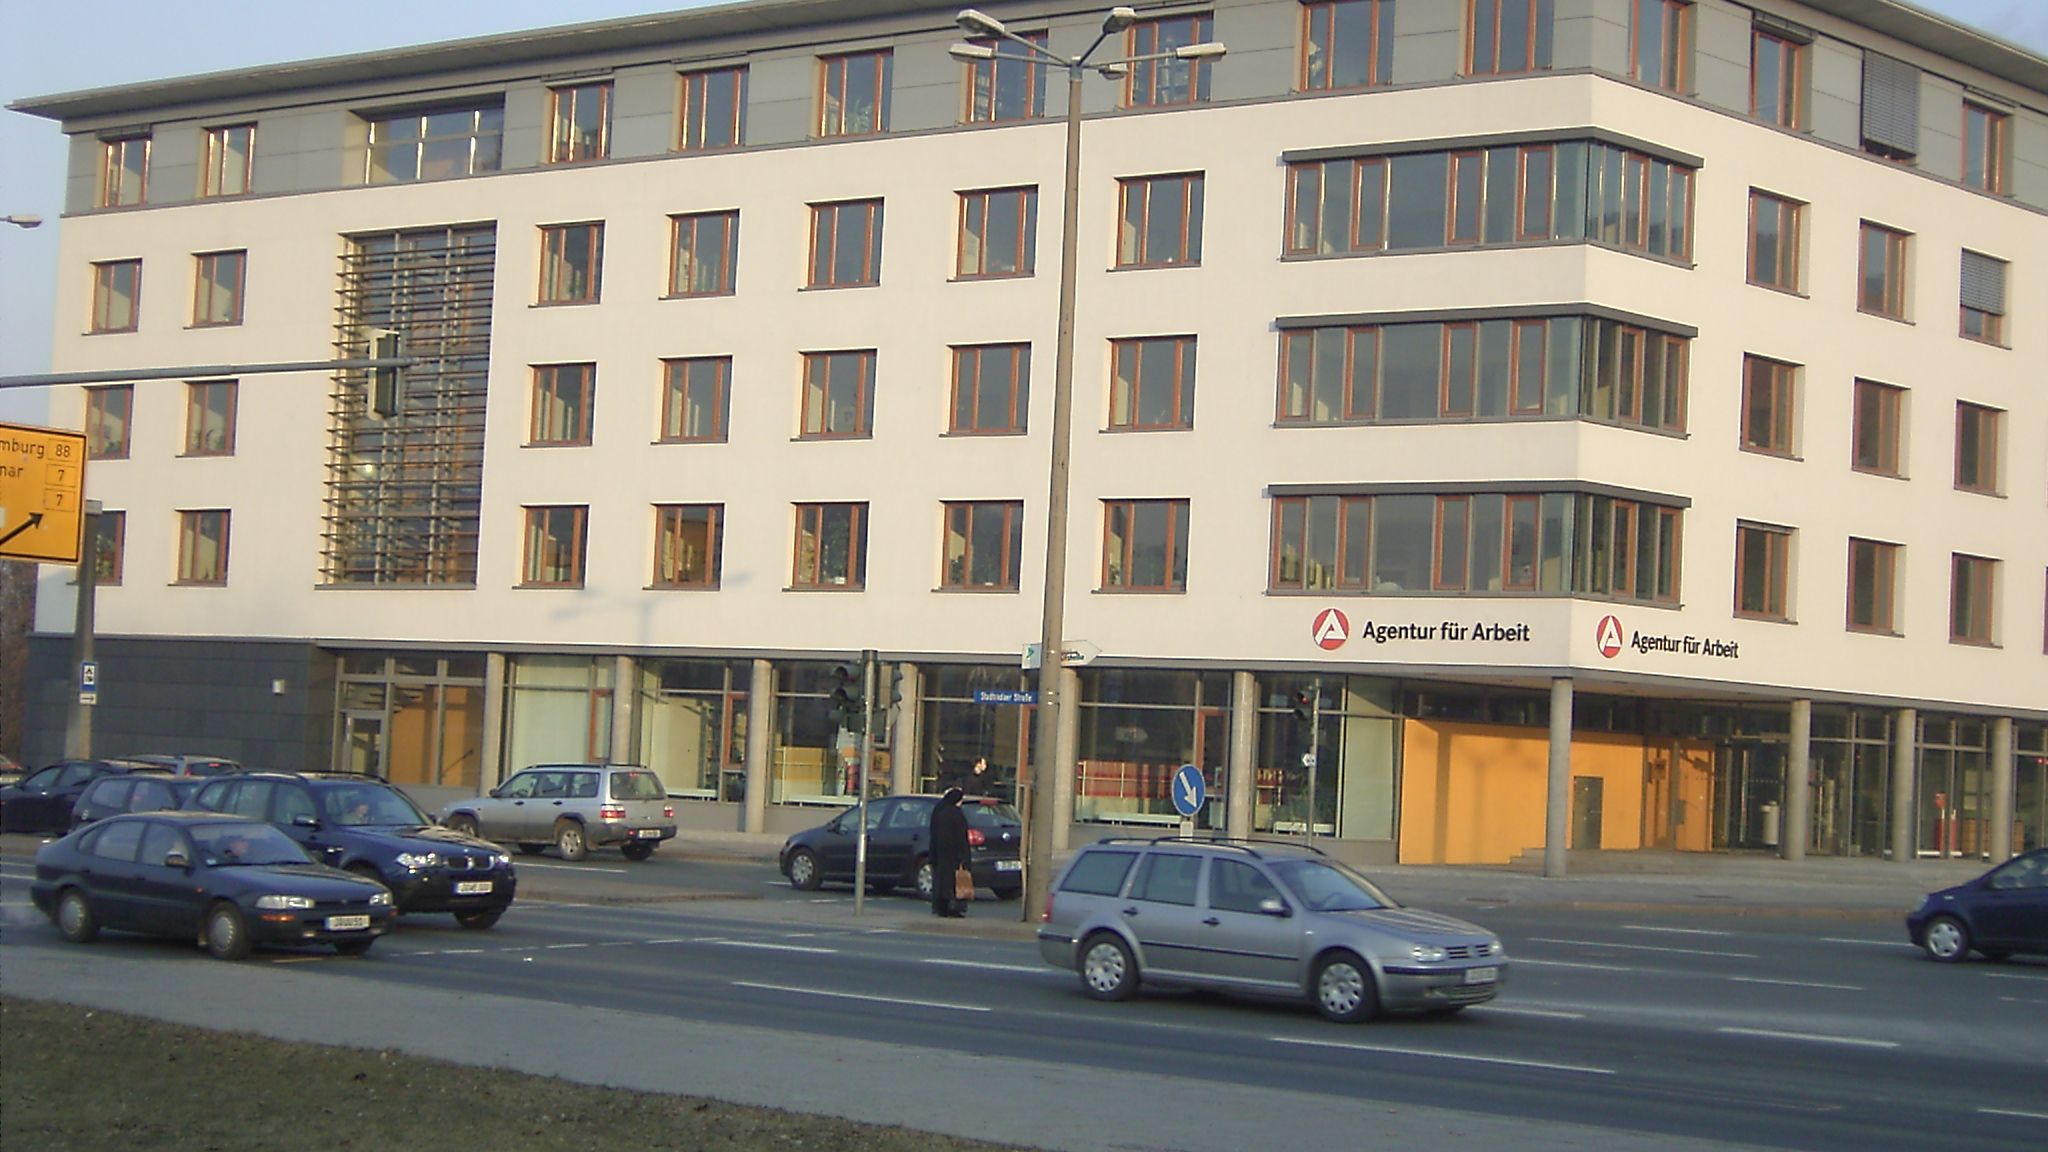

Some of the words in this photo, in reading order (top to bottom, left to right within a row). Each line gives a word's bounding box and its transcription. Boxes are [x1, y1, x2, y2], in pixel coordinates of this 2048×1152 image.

[55, 443, 71, 458] 88
[58, 468, 65, 481] 7
[56, 493, 63, 506] 7
[1362, 620, 1437, 644] Agentur
[1441, 621, 1468, 641] für
[1471, 622, 1531, 642] Arbeit
[1630, 630, 1682, 654] Agentur
[1683, 635, 1701, 655] für
[1702, 637, 1739, 659] Arbeit
